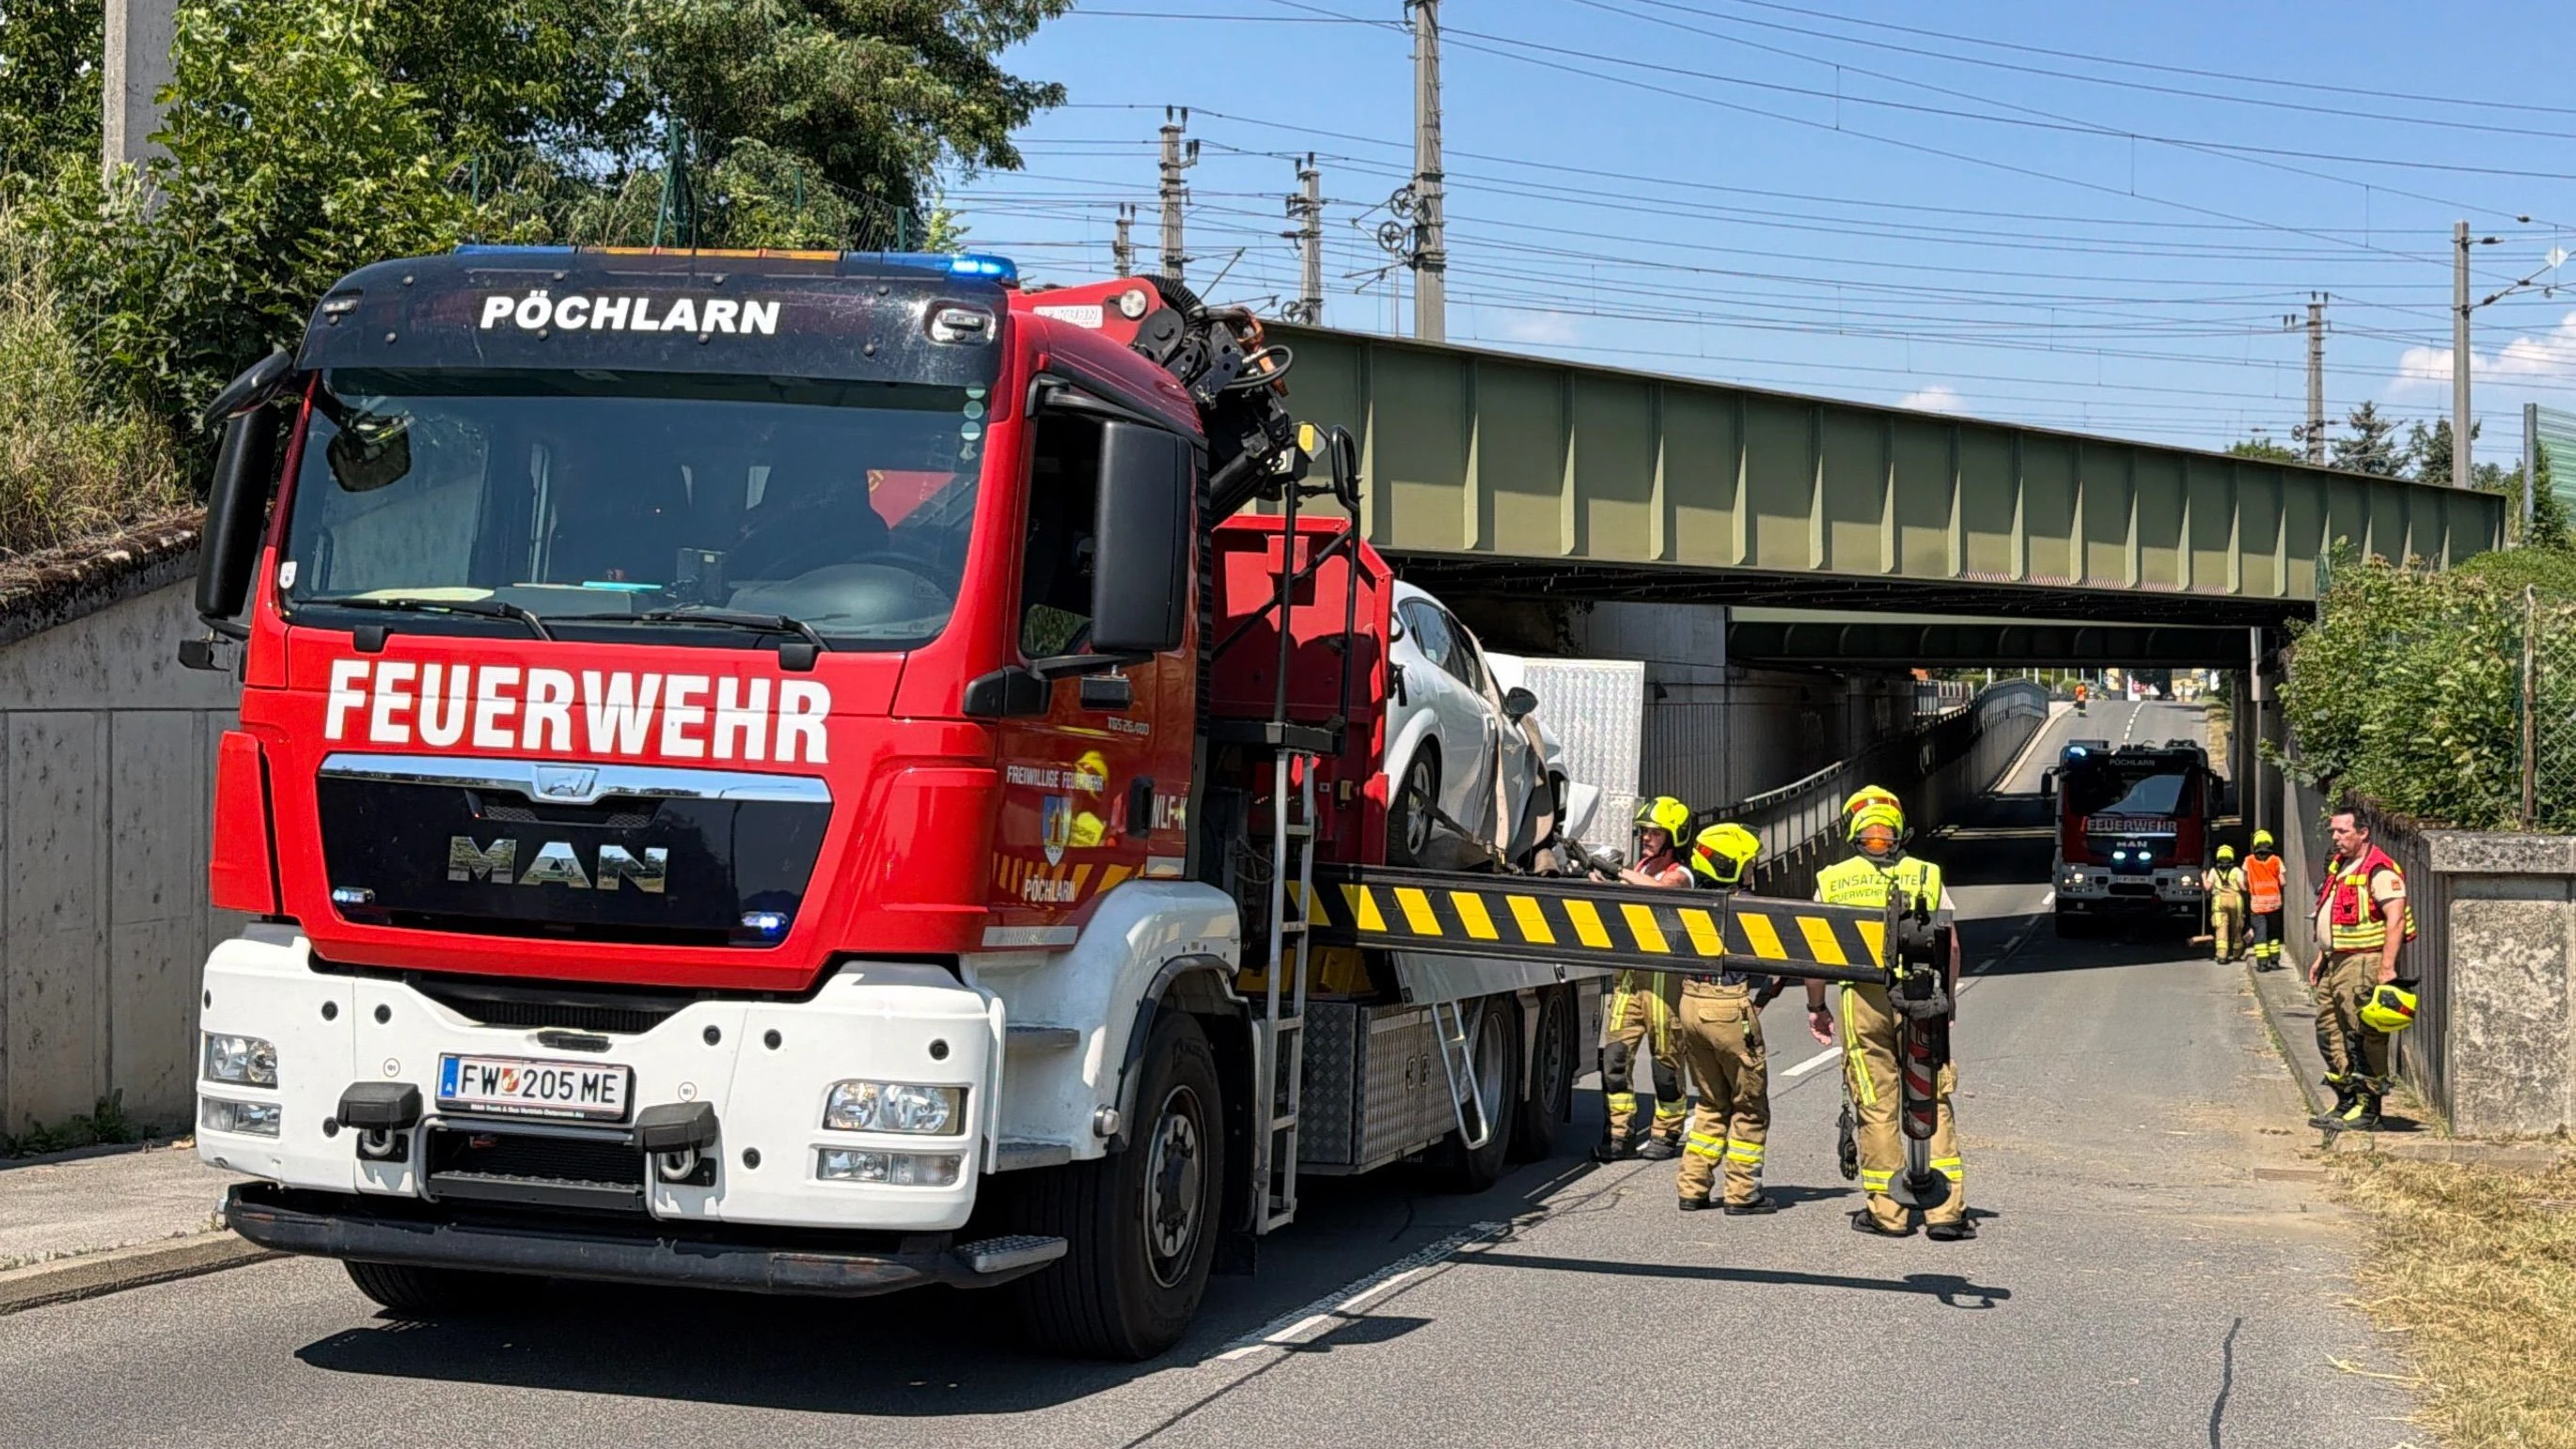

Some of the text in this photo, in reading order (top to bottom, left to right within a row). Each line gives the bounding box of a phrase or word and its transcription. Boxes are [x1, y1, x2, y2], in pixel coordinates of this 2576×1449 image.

[479, 290, 781, 336] PÖCHLARN
[324, 659, 832, 764] FEUERWEHR
[1006, 765, 1060, 788] FREIWILLIGE
[2087, 817, 2178, 832] FEUERWEHR
[448, 835, 669, 893] MAN
[1023, 874, 1076, 903] PÖCHLARN
[445, 1084, 452, 1093] A
[461, 1064, 619, 1104] FW 205 ME
